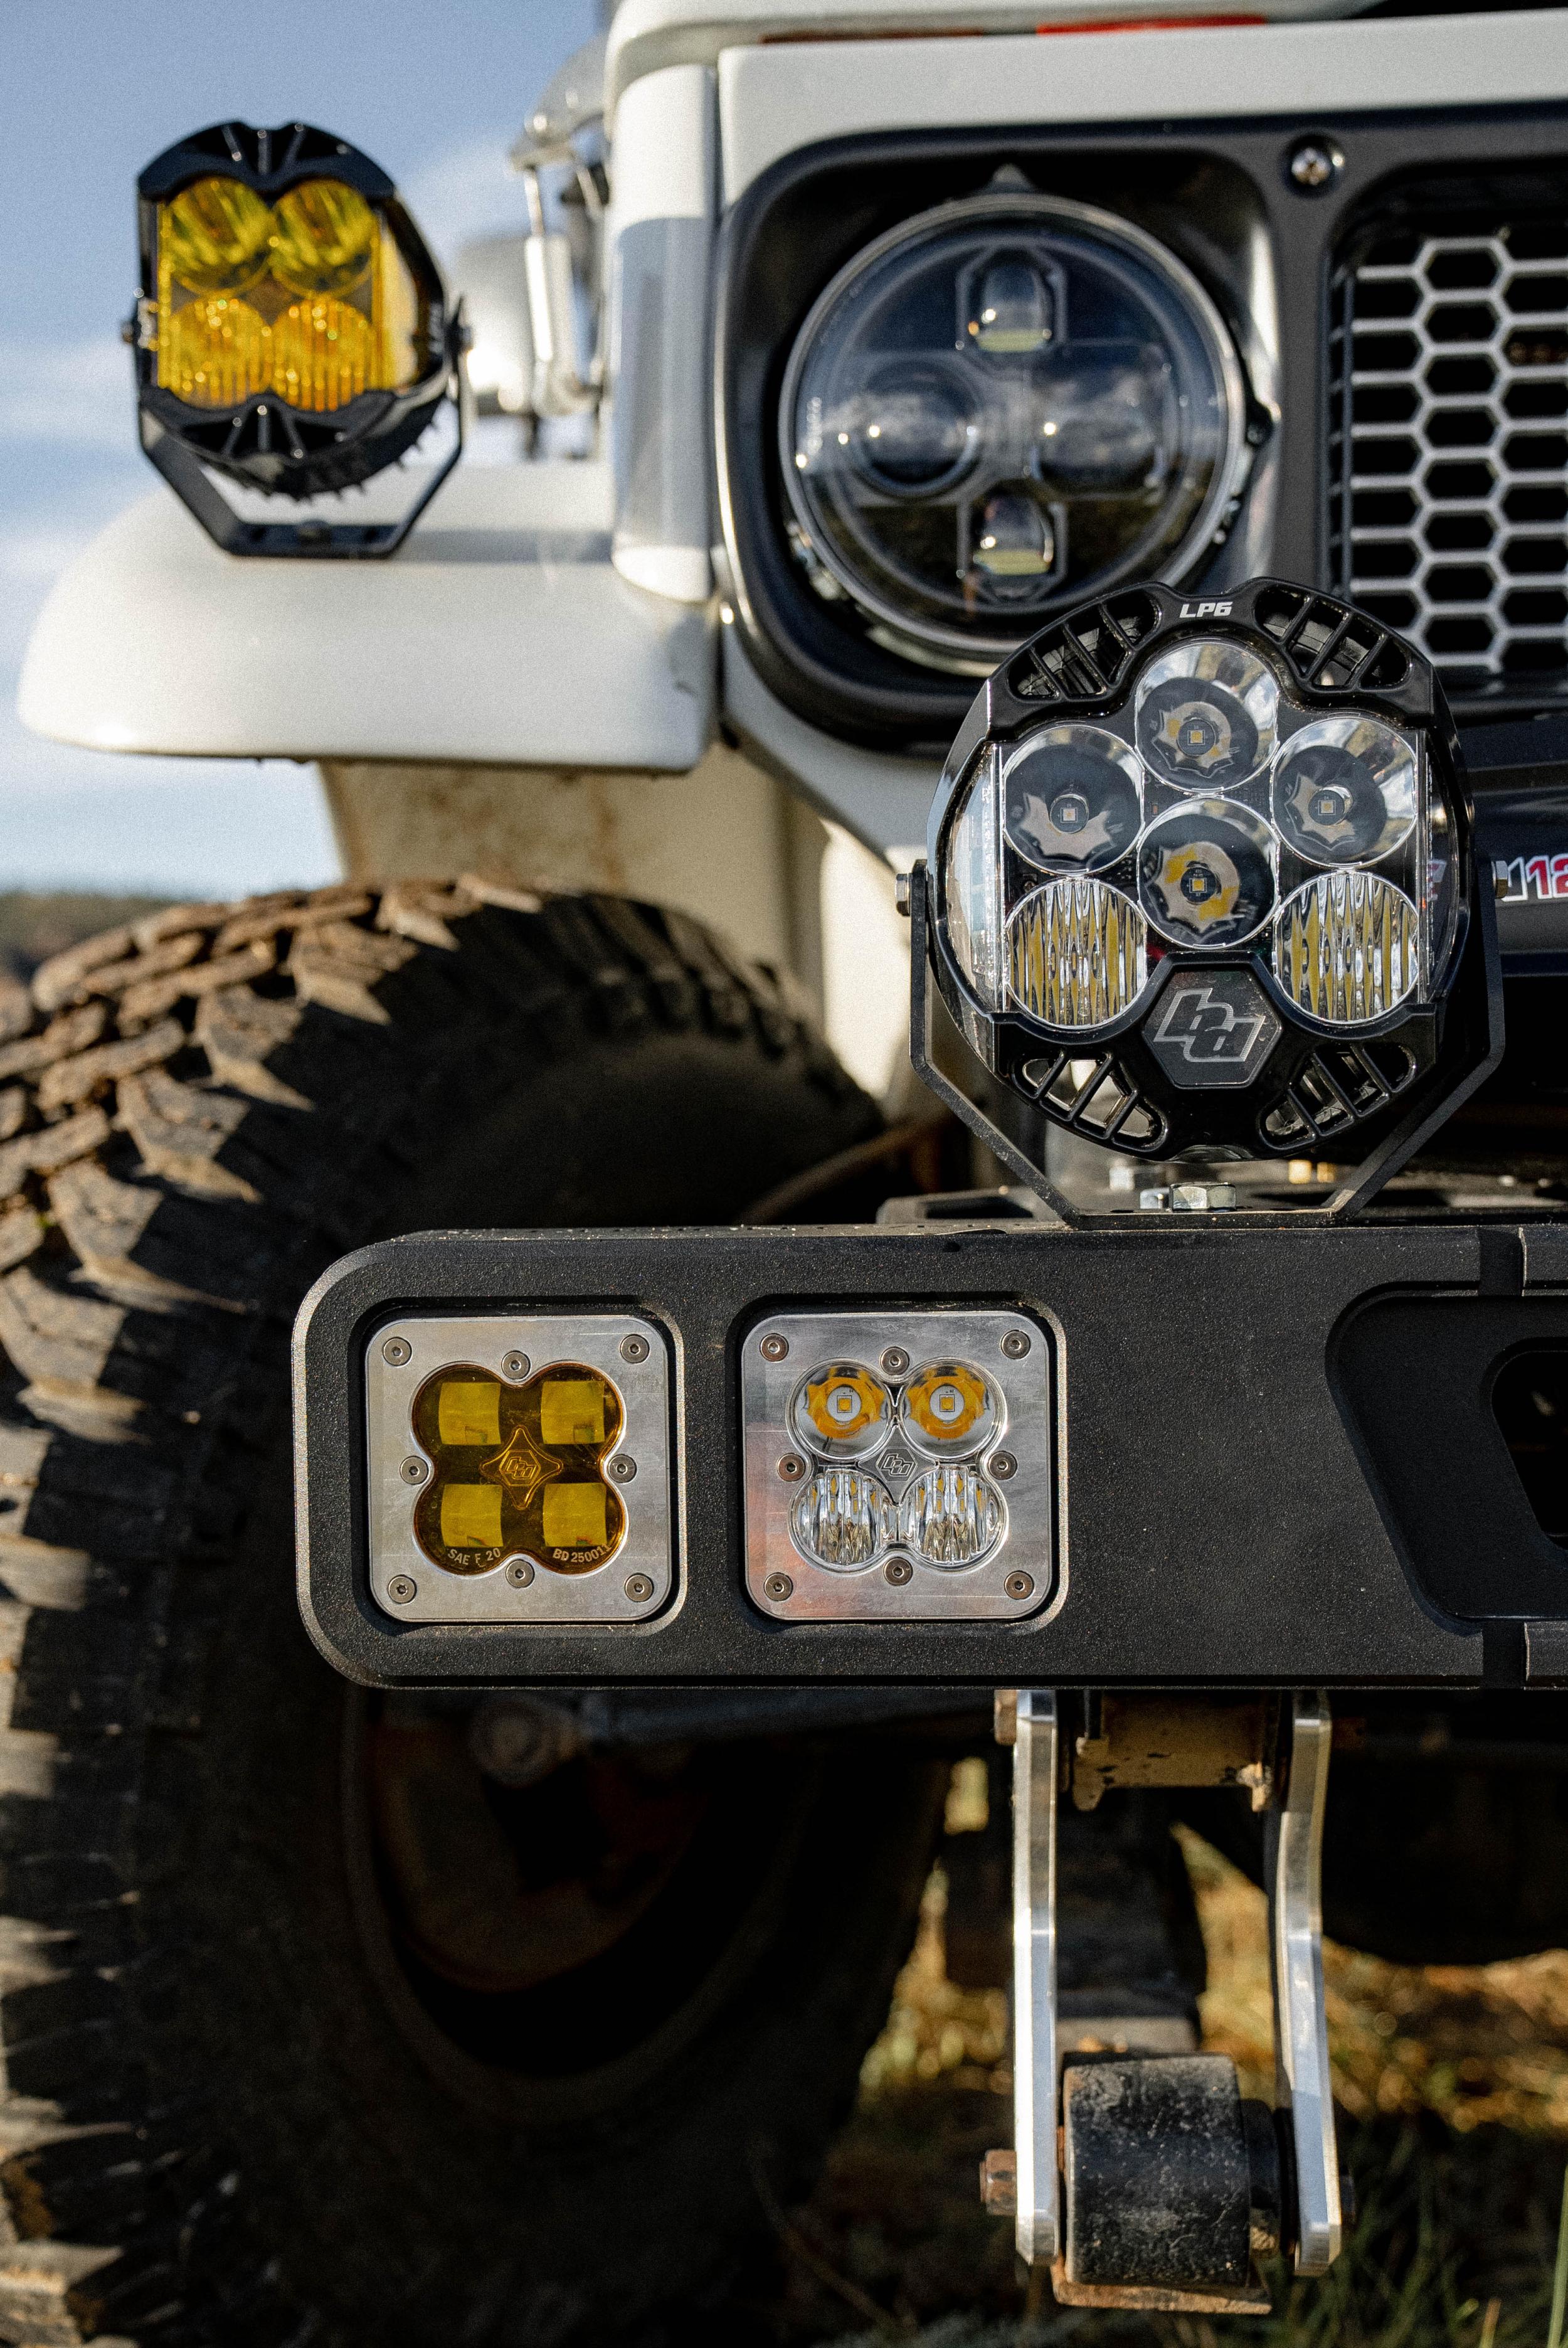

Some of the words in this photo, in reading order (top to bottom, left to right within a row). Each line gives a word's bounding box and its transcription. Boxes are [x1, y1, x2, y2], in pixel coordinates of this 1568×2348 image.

[1179, 602, 1233, 618] LP6
[447, 1549, 470, 1565] SAE
[485, 1548, 501, 1561] 20
[553, 1548, 569, 1561] BD
[571, 1544, 612, 1563] 250011
